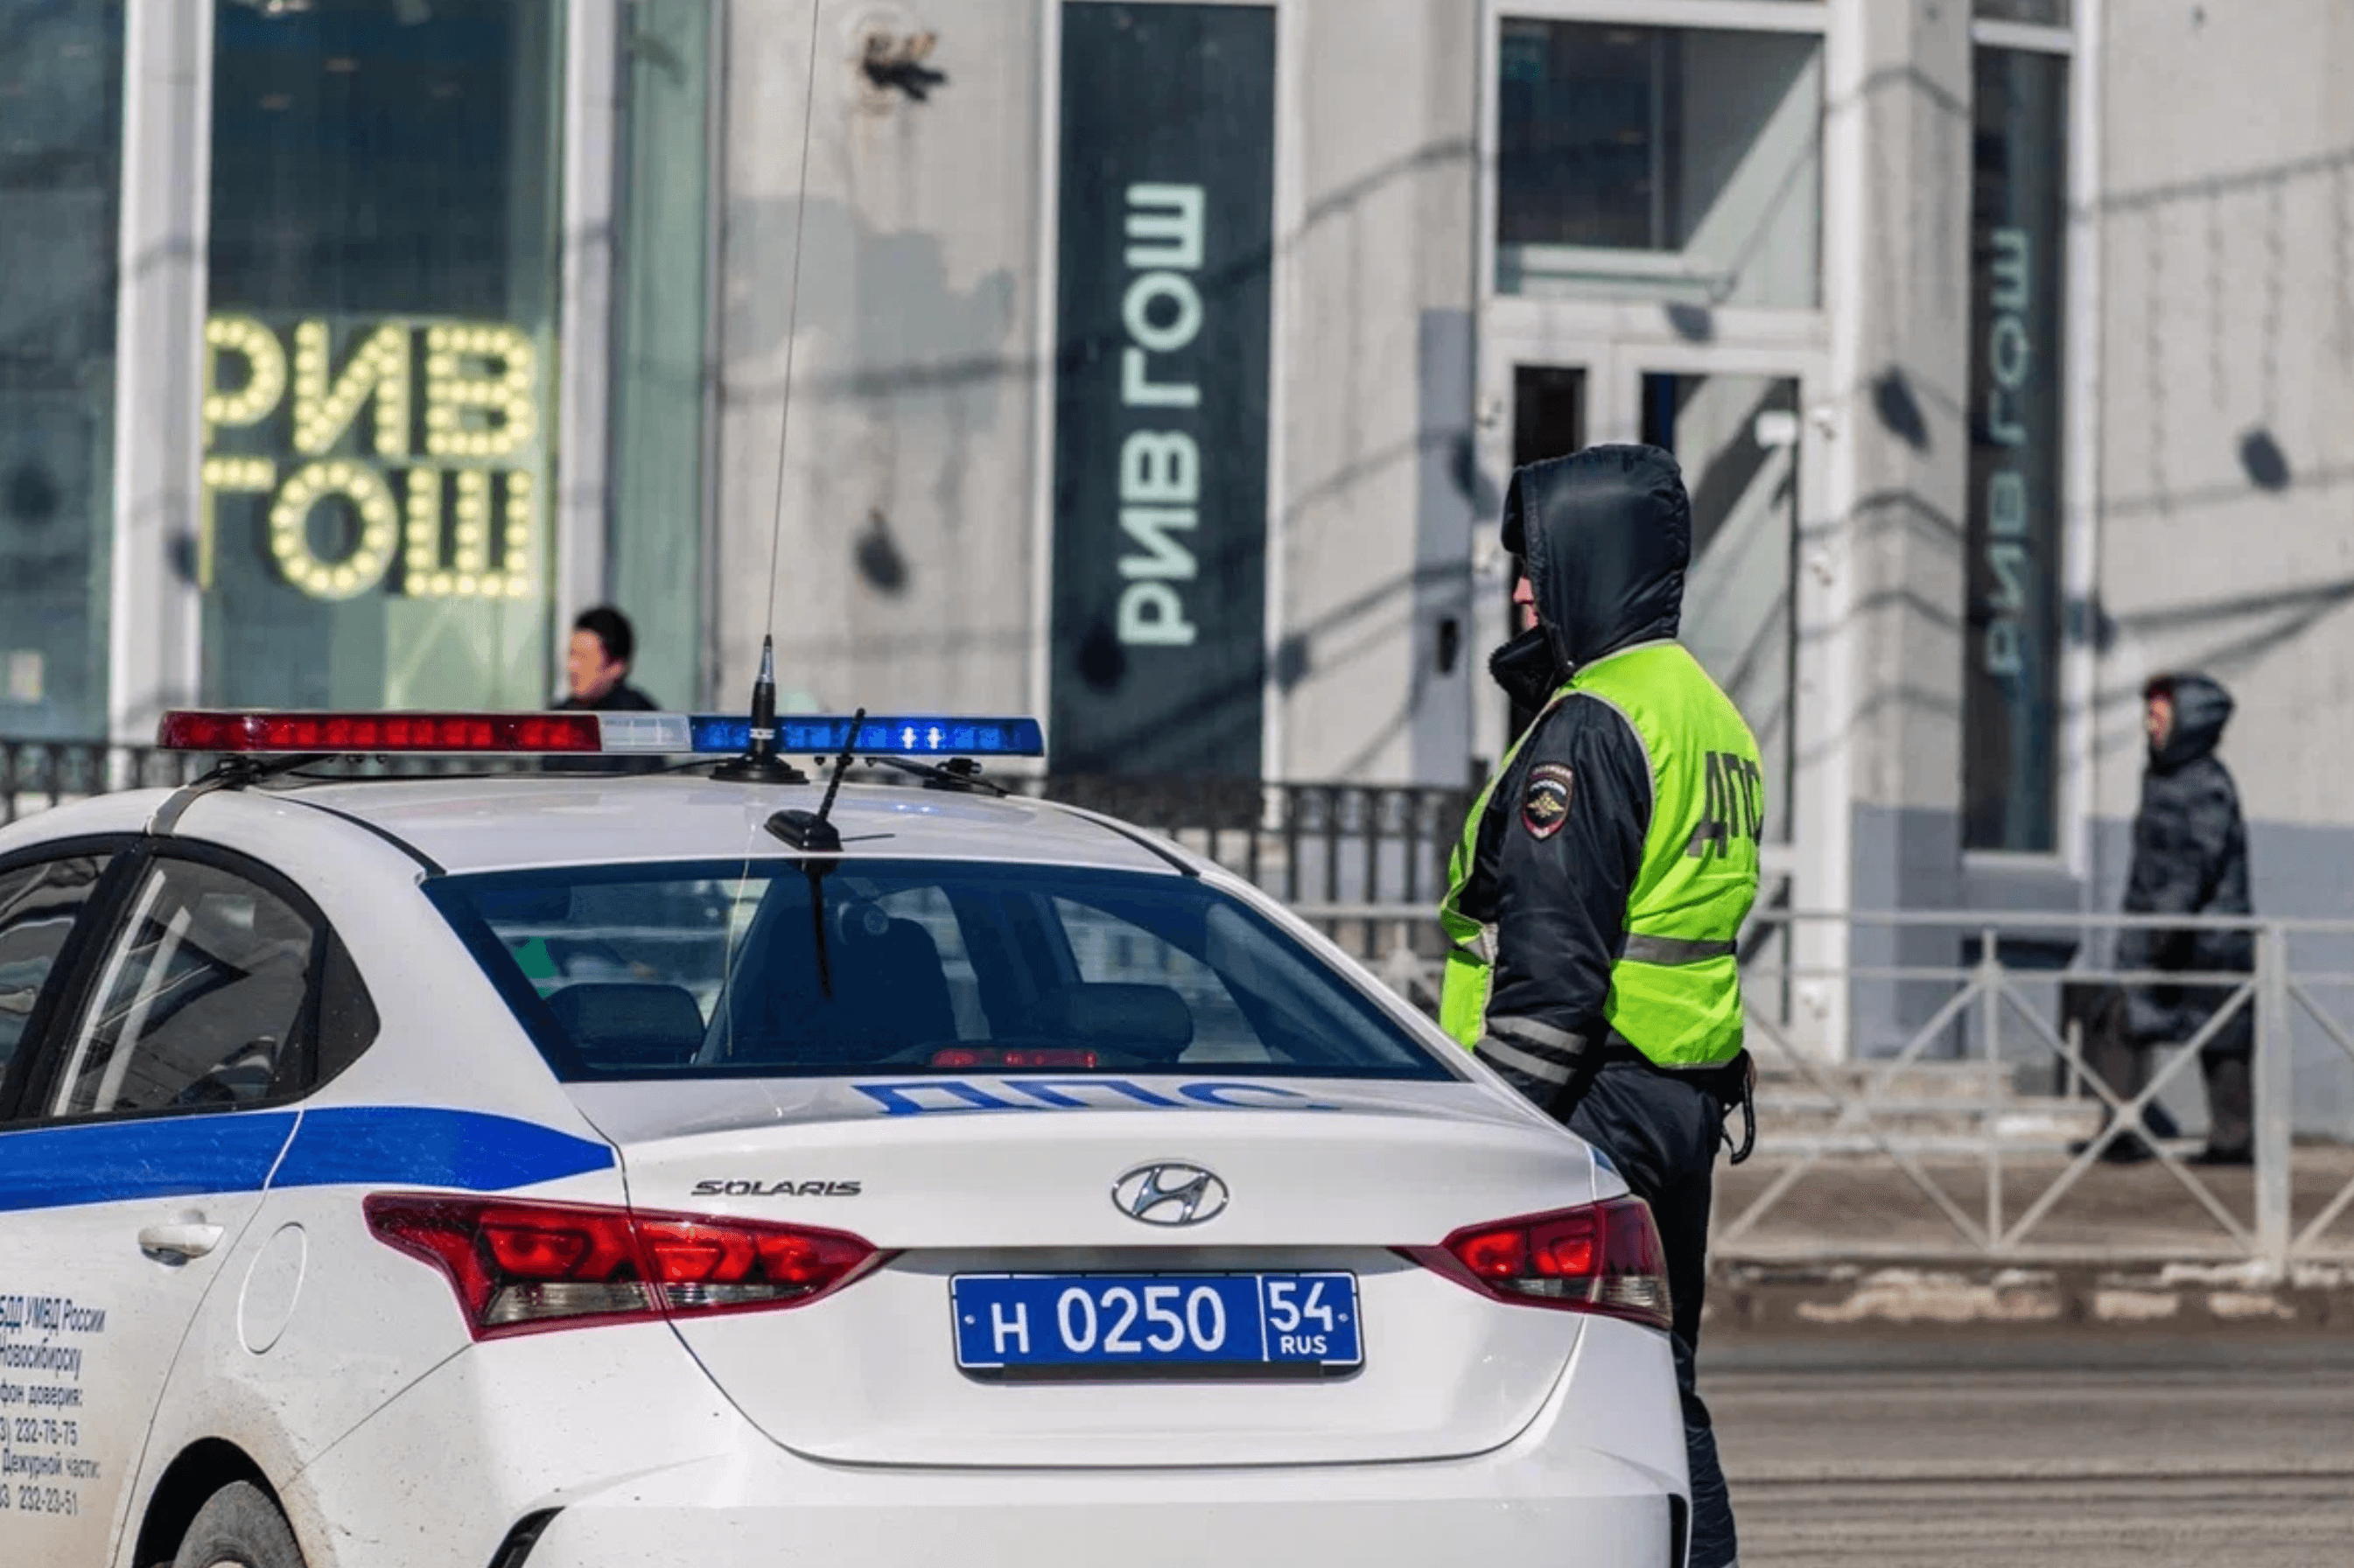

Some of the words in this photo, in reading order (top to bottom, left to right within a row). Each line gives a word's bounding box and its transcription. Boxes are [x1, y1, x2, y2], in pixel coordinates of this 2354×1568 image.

[1122, 182, 1205, 408] ГОШ
[1989, 226, 2030, 445] ГОШ
[202, 313, 539, 463] РИВ
[200, 456, 536, 601] ГОШ
[1117, 429, 1200, 646] РИВ
[1985, 471, 2027, 676] РИВ
[851, 1080, 1342, 1116] ДПС
[691, 1180, 862, 1197] SOLARIS
[25, 1296, 61, 1336] УМВД
[62, 1298, 106, 1333] России
[1056, 1285, 1227, 1354] 0250
[1269, 1281, 1335, 1333] 54
[1280, 1335, 1328, 1355] RUS
[28, 1385, 82, 1411] доверия:
[16, 1418, 78, 1446] 232-76-75
[3, 1447, 62, 1480] Дежурной
[18, 1484, 78, 1516] 232-23-51
